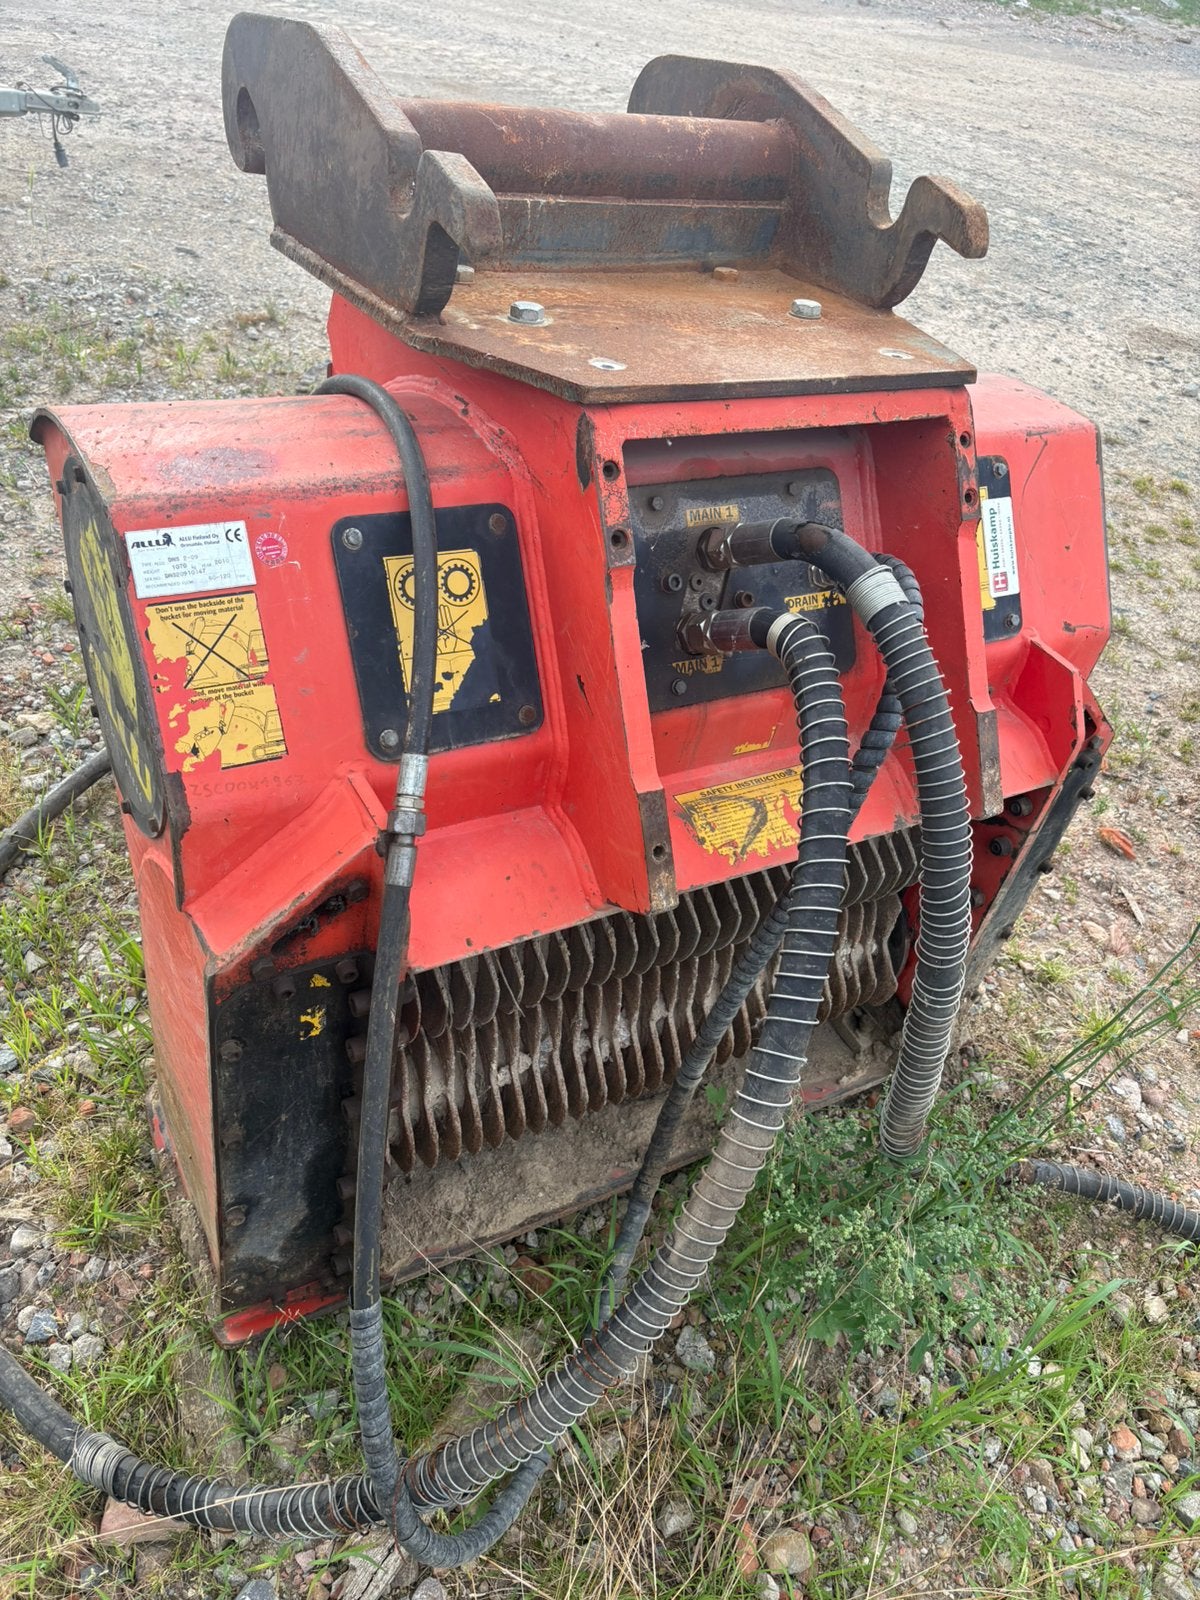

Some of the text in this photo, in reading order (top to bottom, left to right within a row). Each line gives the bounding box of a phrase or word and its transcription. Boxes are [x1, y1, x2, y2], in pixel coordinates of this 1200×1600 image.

[689, 507, 734, 522] MAIN 1
[989, 507, 1001, 570] Huiskamp
[155, 605, 173, 615] Don't
[187, 602, 197, 610] the
[198, 599, 226, 608] backside
[787, 594, 819, 609] DRAIN
[160, 613, 182, 621] bucket
[193, 608, 217, 617] moving
[218, 604, 244, 613] material
[675, 658, 720, 674] MAIN 1
[207, 687, 225, 695] move
[222, 692, 233, 700] the
[233, 690, 255, 698] bucket
[699, 768, 798, 798] SAFETY INSTRUCTIO
